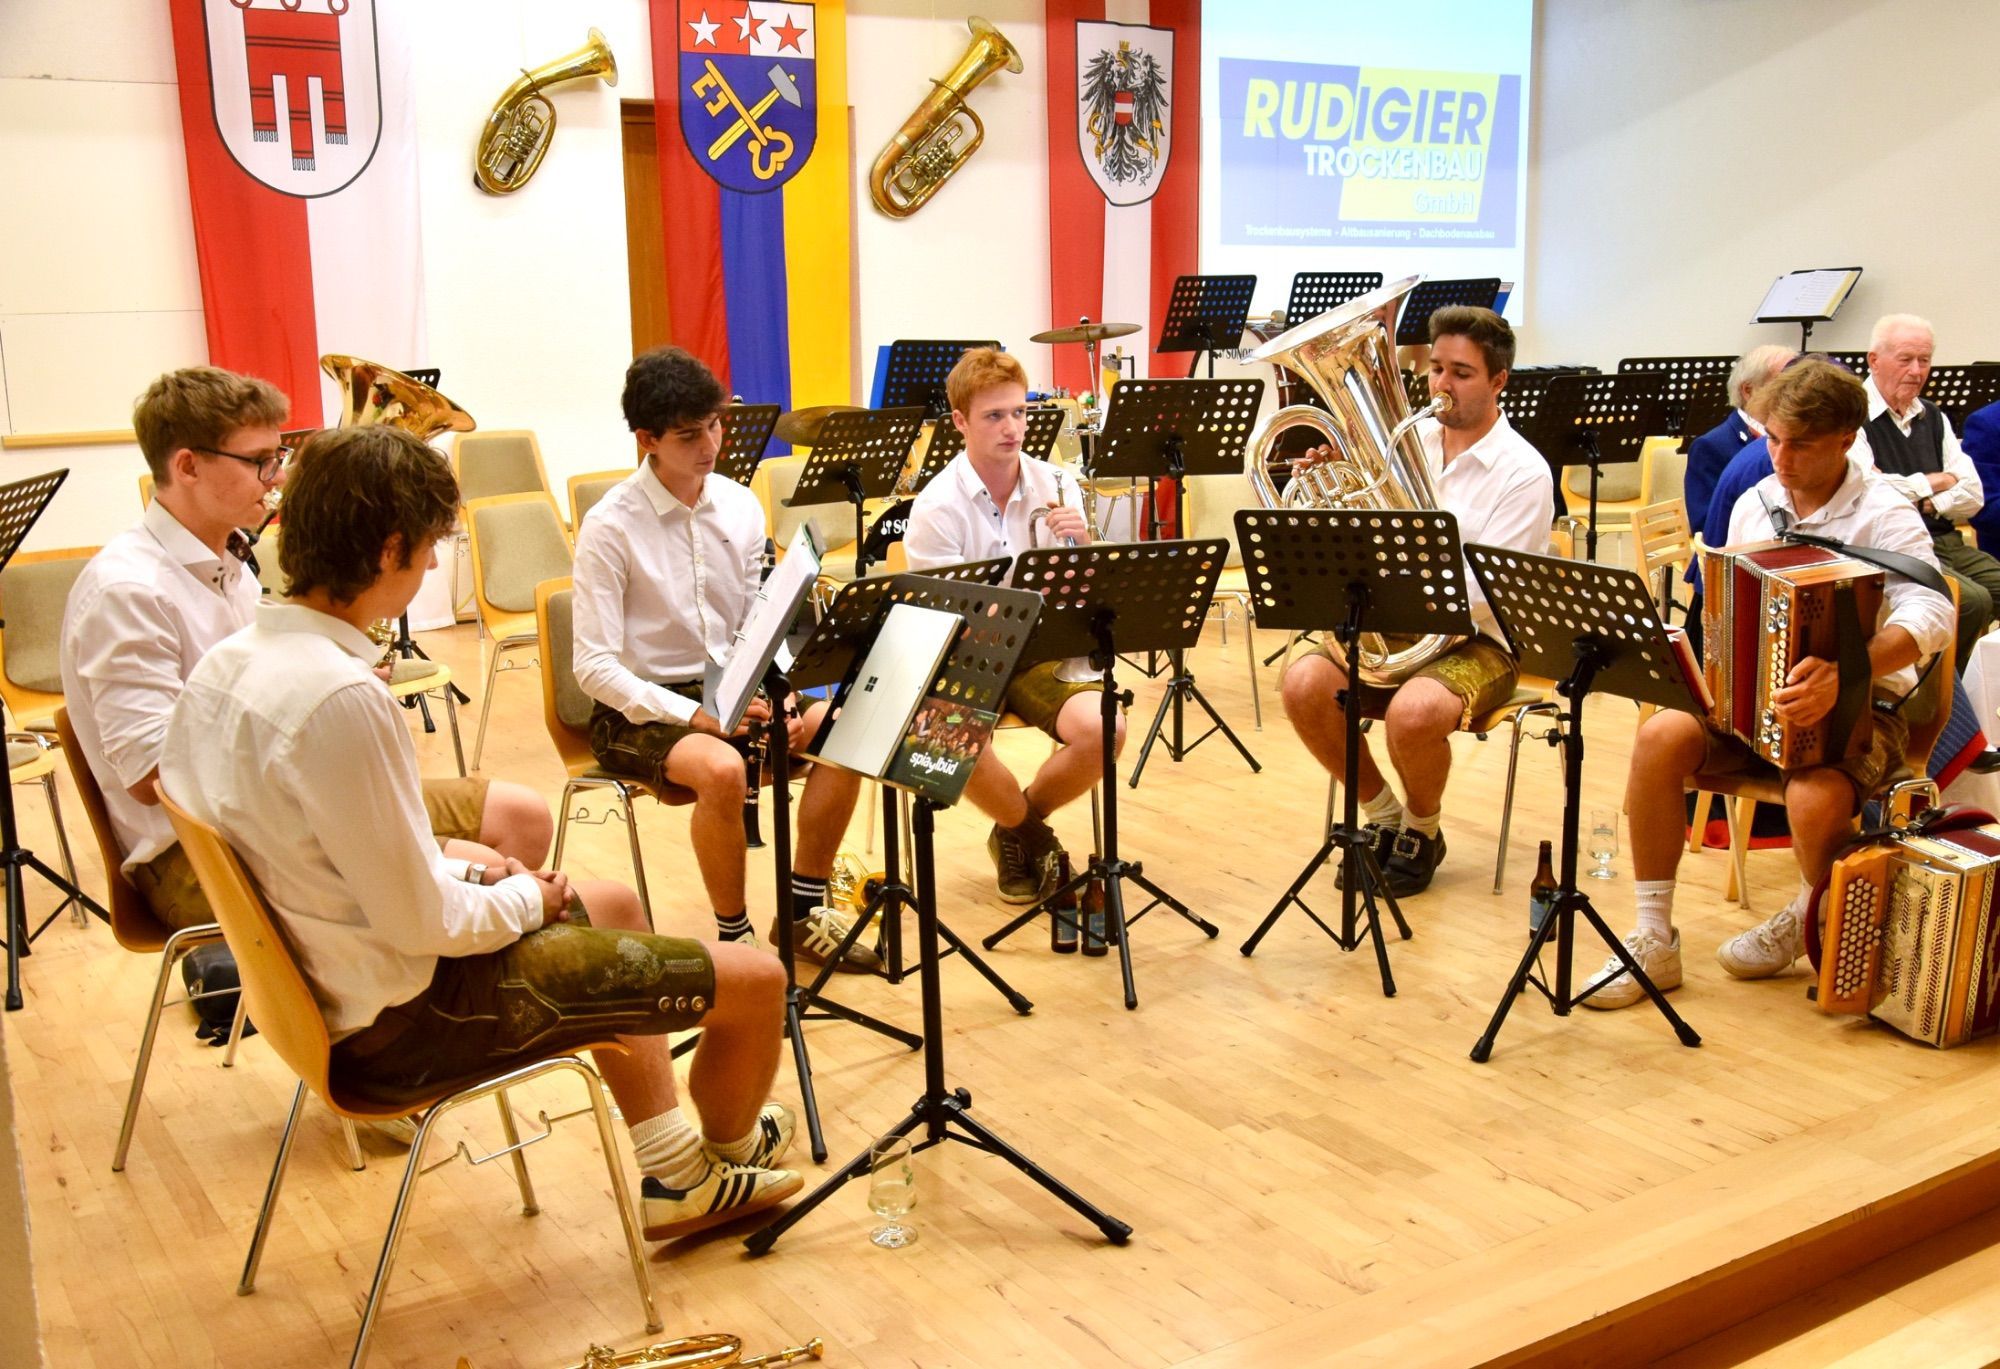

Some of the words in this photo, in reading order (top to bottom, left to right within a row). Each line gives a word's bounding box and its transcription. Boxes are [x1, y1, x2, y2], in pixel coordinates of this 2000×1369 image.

[1243, 77, 1488, 146] RUDIGIER
[1303, 143, 1482, 181] TROCKENBAU
[1414, 190, 1475, 214] GmbH
[1341, 225, 1411, 241] Altbausanierung
[1419, 227, 1496, 240] Dachbodenausbau
